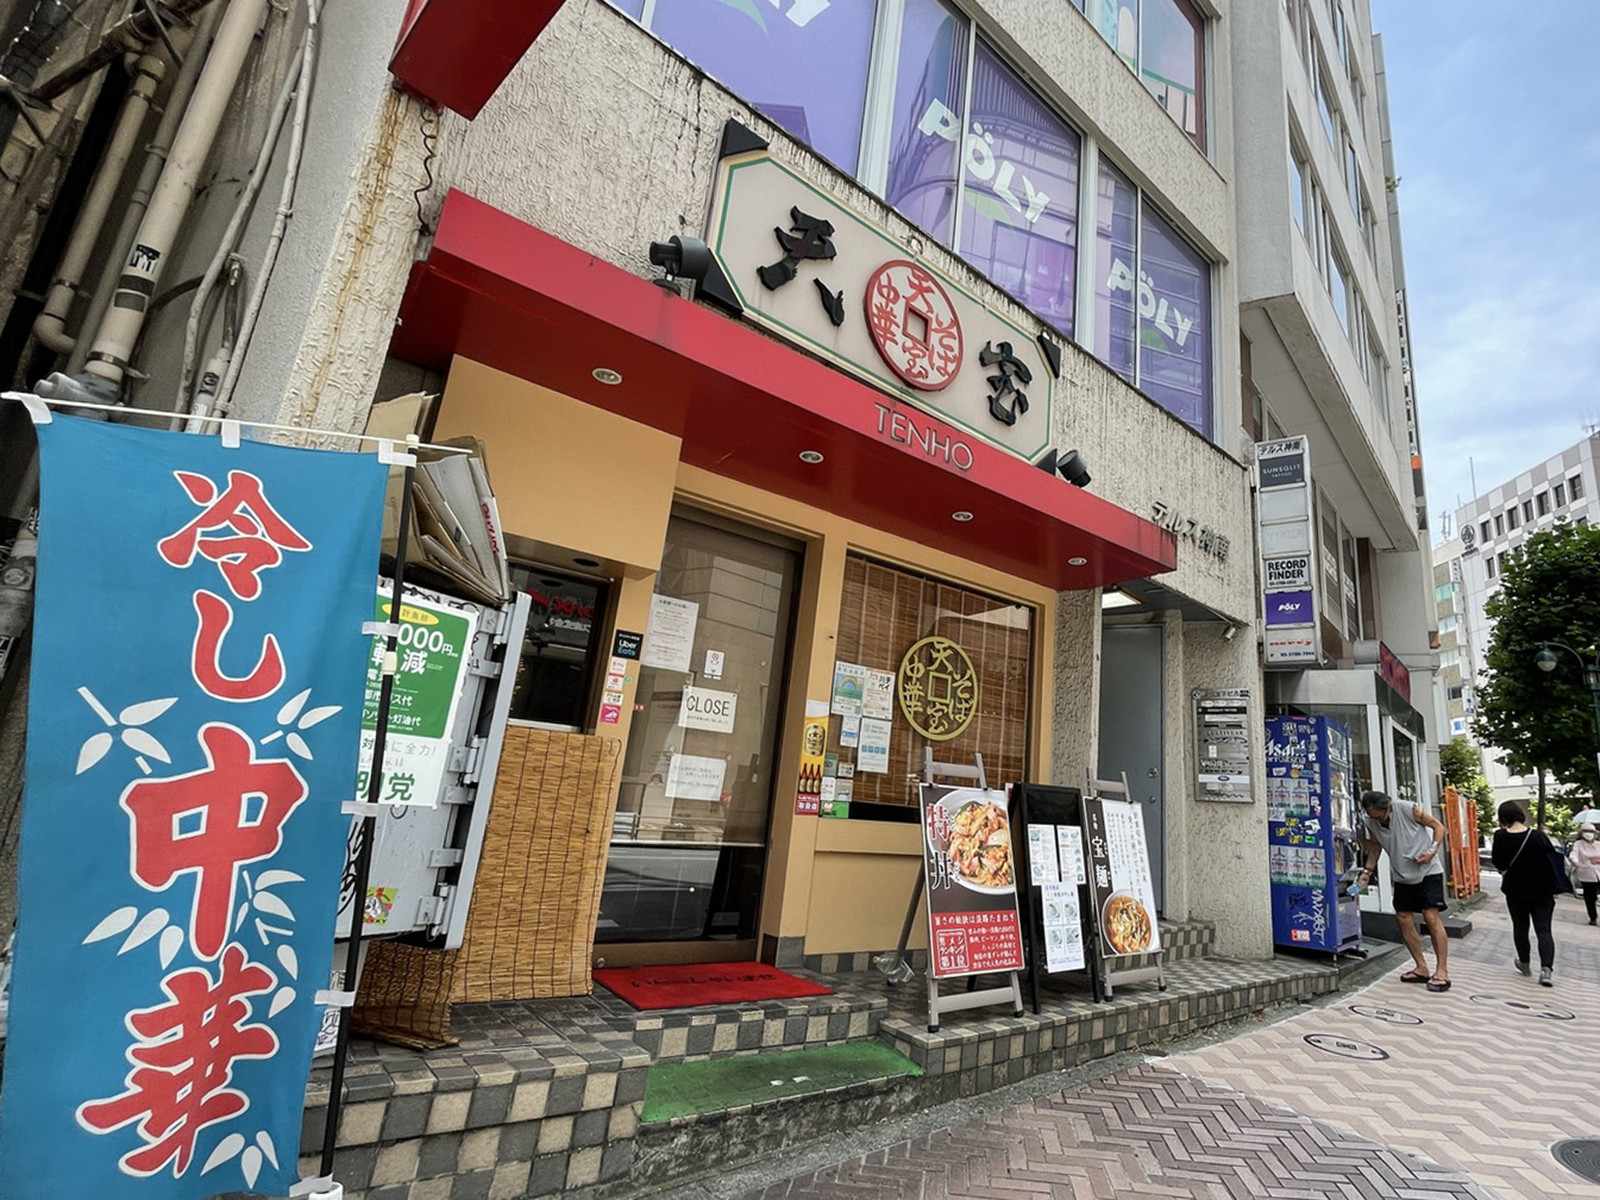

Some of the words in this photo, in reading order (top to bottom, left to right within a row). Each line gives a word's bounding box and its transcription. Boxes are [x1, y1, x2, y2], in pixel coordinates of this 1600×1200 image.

[874, 402, 974, 472] TENHO
[1268, 559, 1307, 571] RECORD
[1268, 569, 1305, 581] FINDER
[686, 694, 731, 717] CLOSE
[75, 468, 313, 1178] 冷し中華
